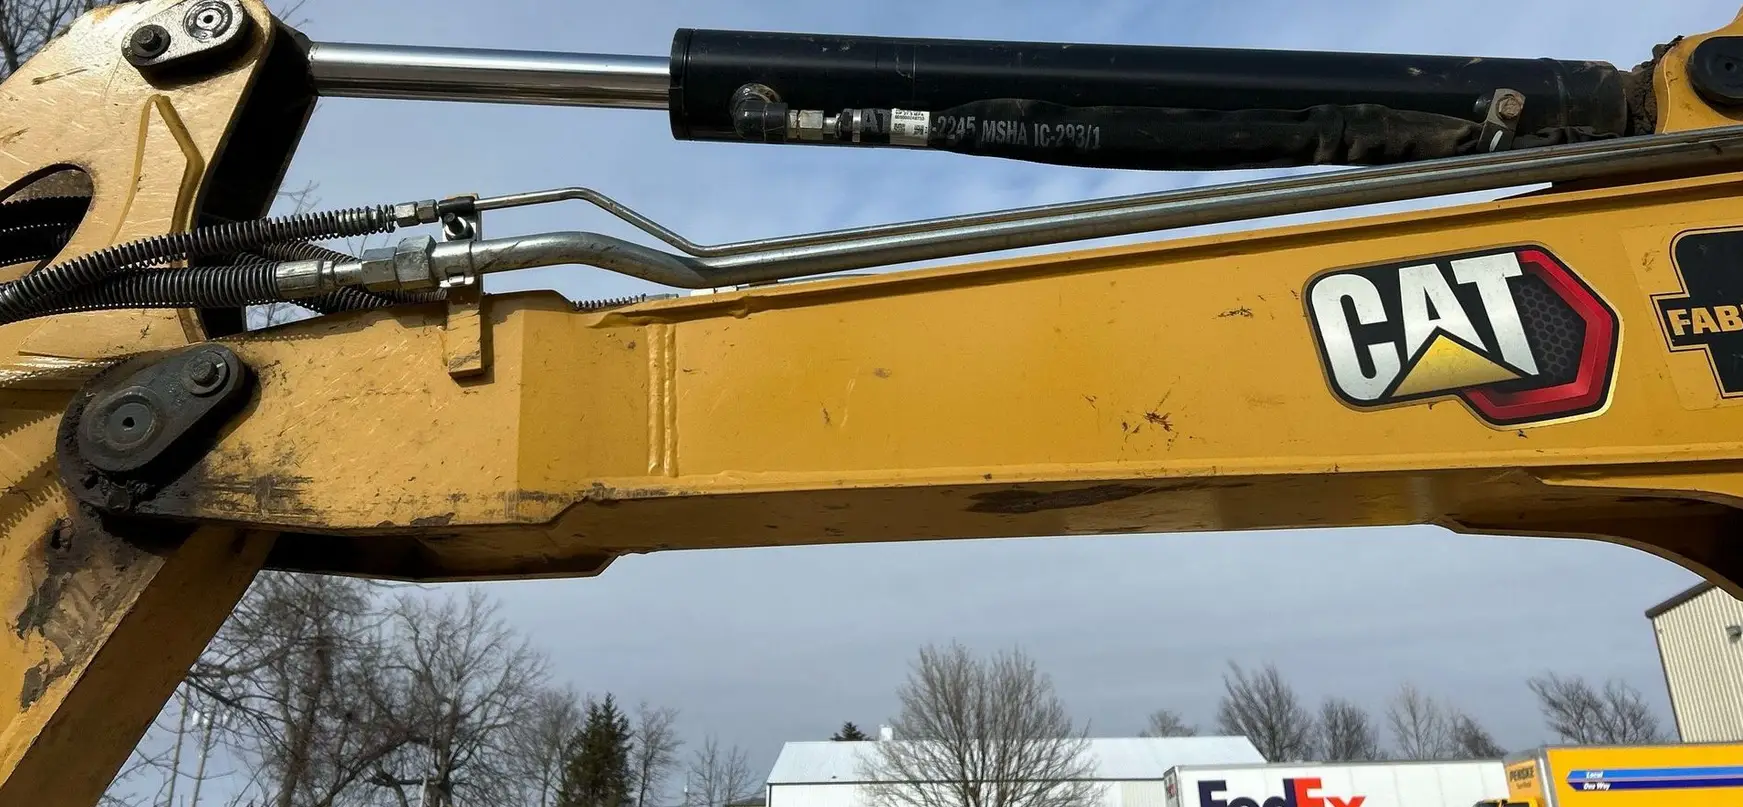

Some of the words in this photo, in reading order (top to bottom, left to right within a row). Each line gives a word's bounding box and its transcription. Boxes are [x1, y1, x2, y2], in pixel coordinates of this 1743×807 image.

[981, 120, 1028, 144] MSHA
[1034, 123, 1100, 150] IC-293/1
[1311, 252, 1540, 400] CAT
[1667, 304, 1743, 336] FAB
